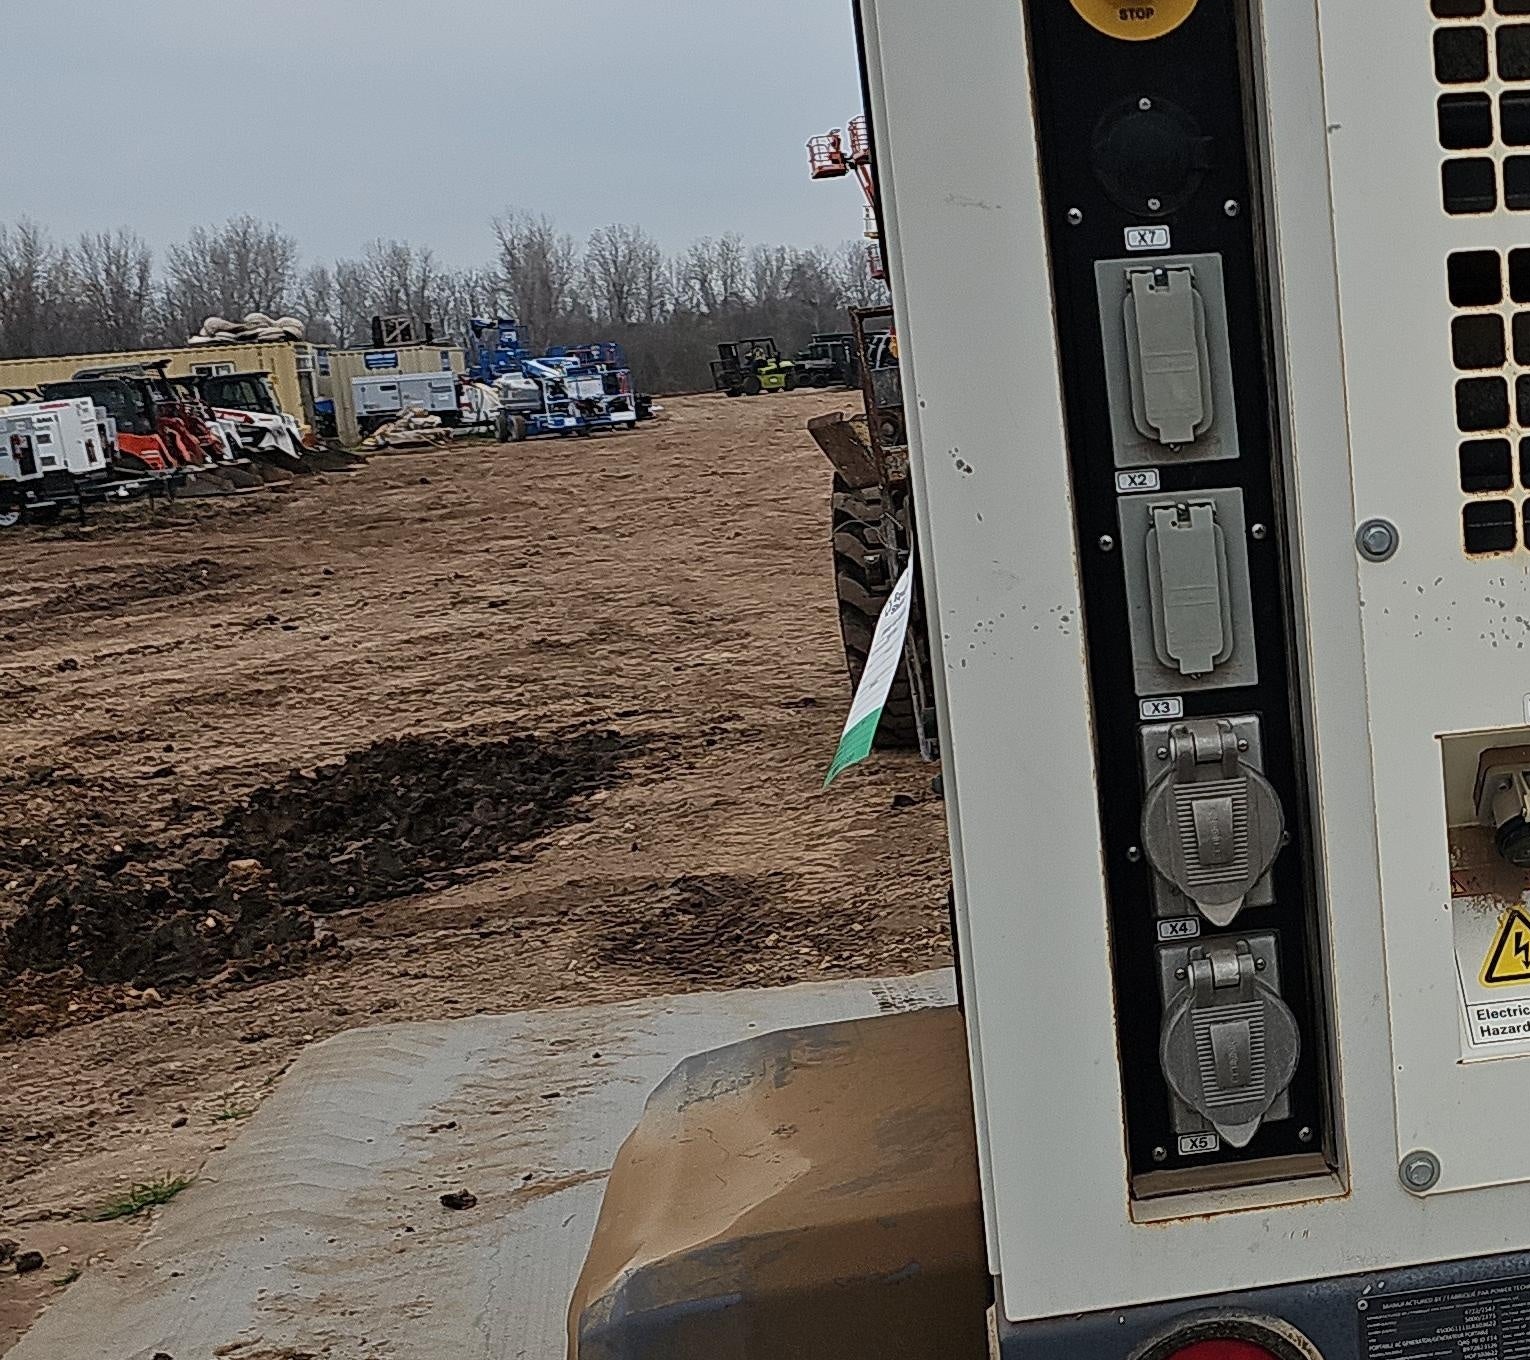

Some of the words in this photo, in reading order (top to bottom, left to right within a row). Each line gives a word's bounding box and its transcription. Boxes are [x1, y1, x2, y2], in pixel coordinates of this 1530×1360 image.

[1118, 6, 1155, 21] STOP
[1128, 473, 1147, 486] X2
[1152, 702, 1171, 715] X3
[1169, 923, 1188, 936] X4
[1189, 1136, 1208, 1149] X5
